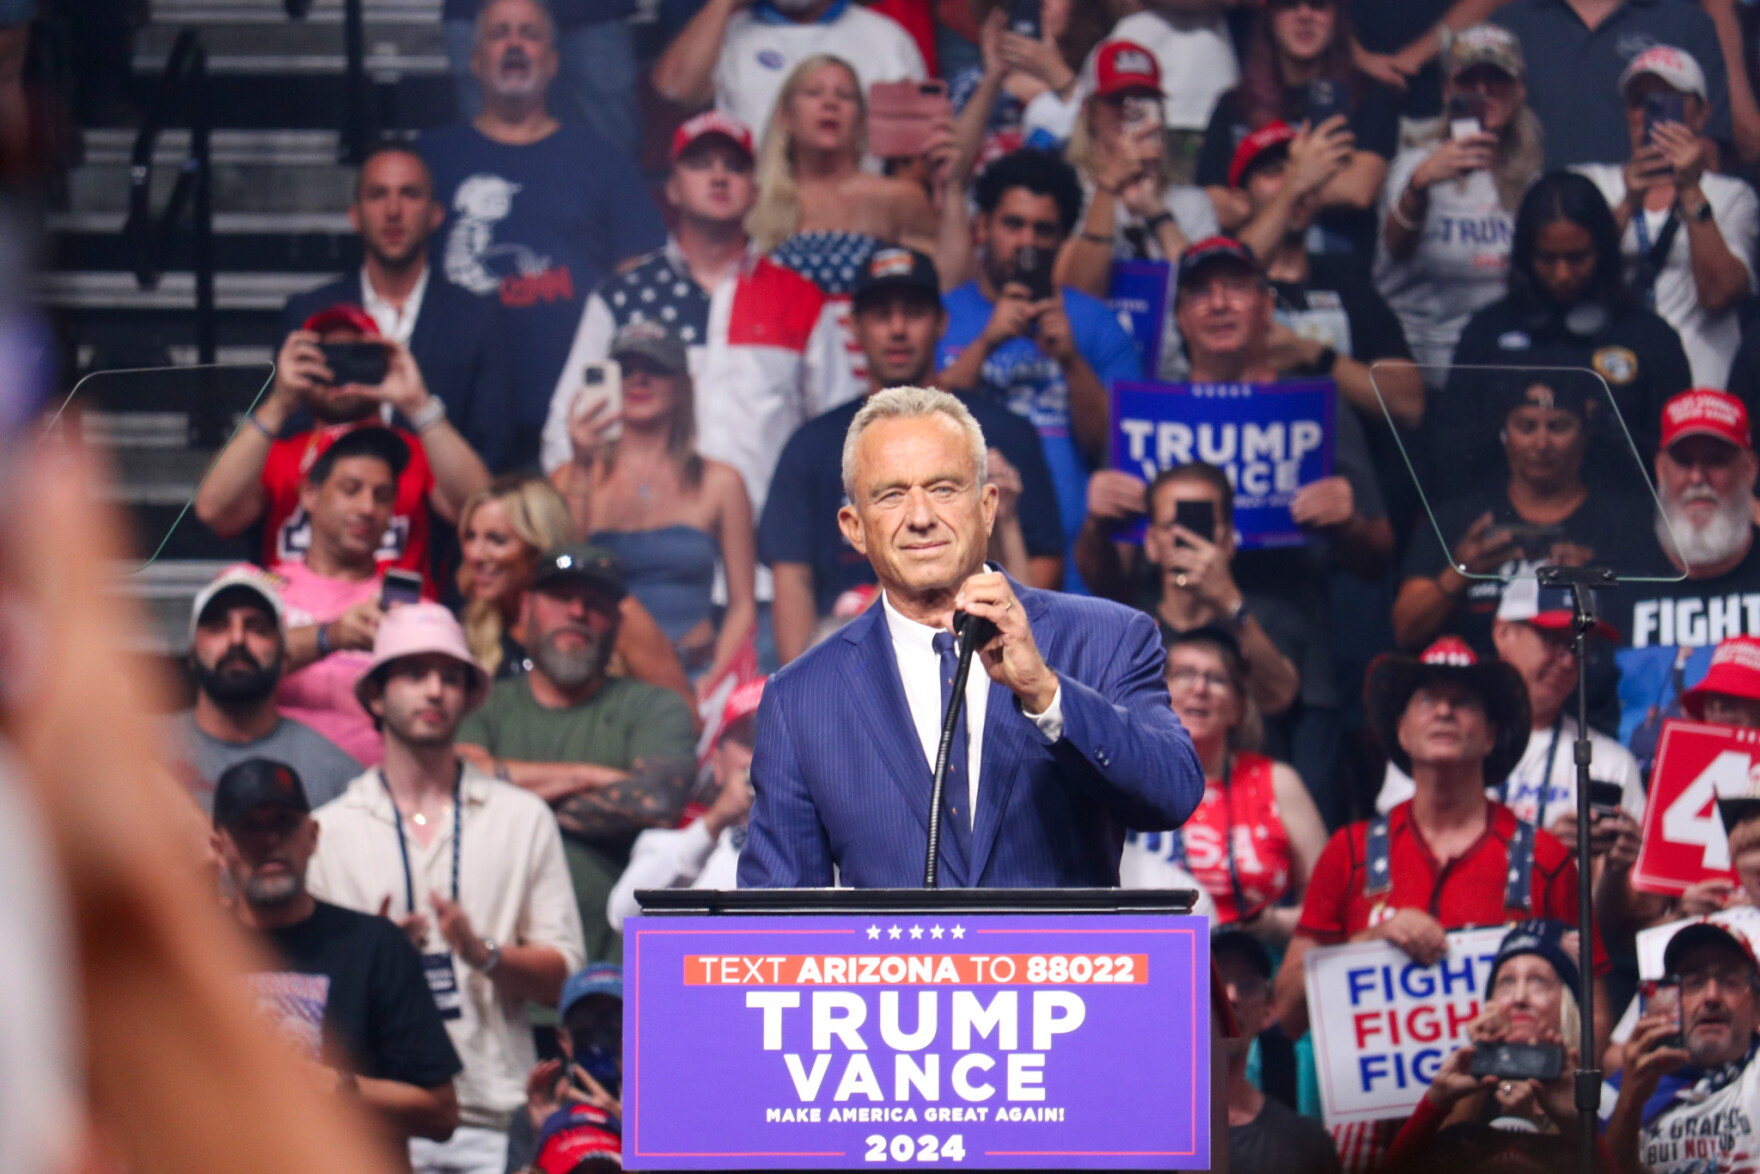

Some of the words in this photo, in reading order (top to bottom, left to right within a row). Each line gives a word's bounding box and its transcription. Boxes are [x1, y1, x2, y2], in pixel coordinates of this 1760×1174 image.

[1120, 417, 1323, 471] TRUMP
[1632, 592, 1760, 648] FIGHT
[699, 957, 787, 983] TEXT
[797, 956, 960, 983] ARIZONA
[970, 956, 1015, 983] TO
[1027, 956, 1134, 983] 88022
[746, 991, 1086, 1051] TRUMP
[1353, 1001, 1479, 1048] FIGH
[784, 1053, 1046, 1102] VANCE
[1358, 1046, 1446, 1092] FIG
[766, 1108, 821, 1122] MAKE
[828, 1108, 918, 1122] AMERICA
[924, 1108, 989, 1122] GREAT
[995, 1108, 1065, 1122] AGAIN!
[865, 1134, 966, 1162] 2024
[1647, 1140, 1678, 1165] BUT
